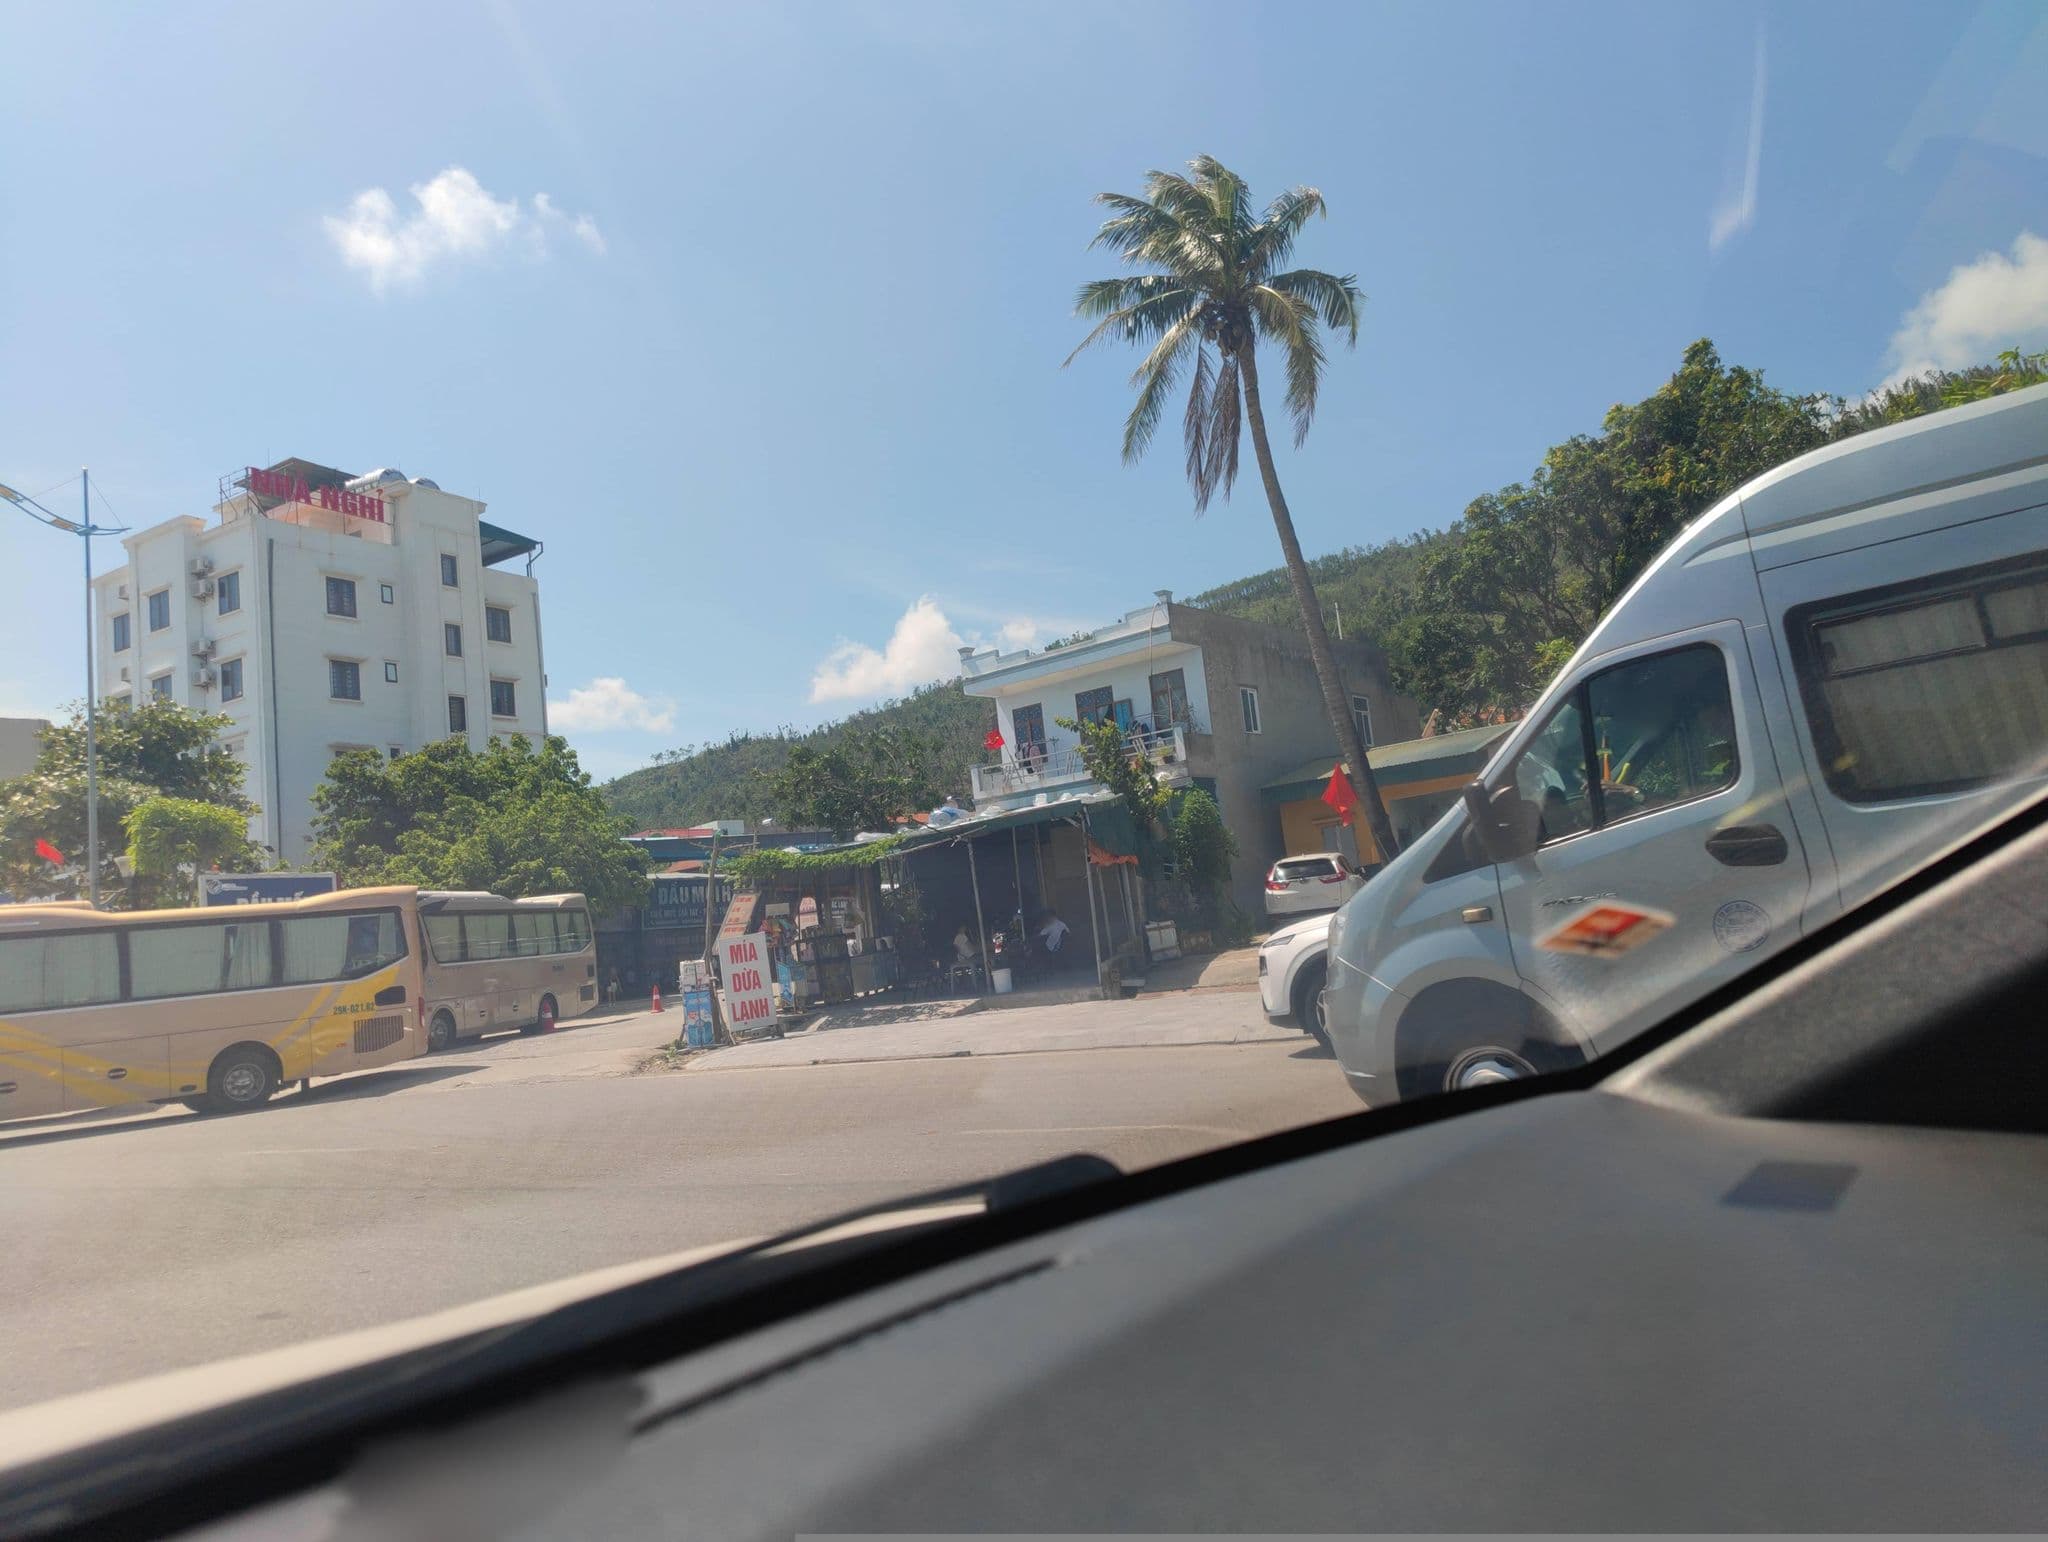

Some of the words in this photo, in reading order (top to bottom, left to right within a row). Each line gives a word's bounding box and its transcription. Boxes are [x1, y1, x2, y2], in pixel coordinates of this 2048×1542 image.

[320, 484, 385, 523] NGHỈ
[729, 939, 759, 965] MÍA
[732, 967, 762, 993] DỪA
[731, 998, 770, 1025] LẠNH
